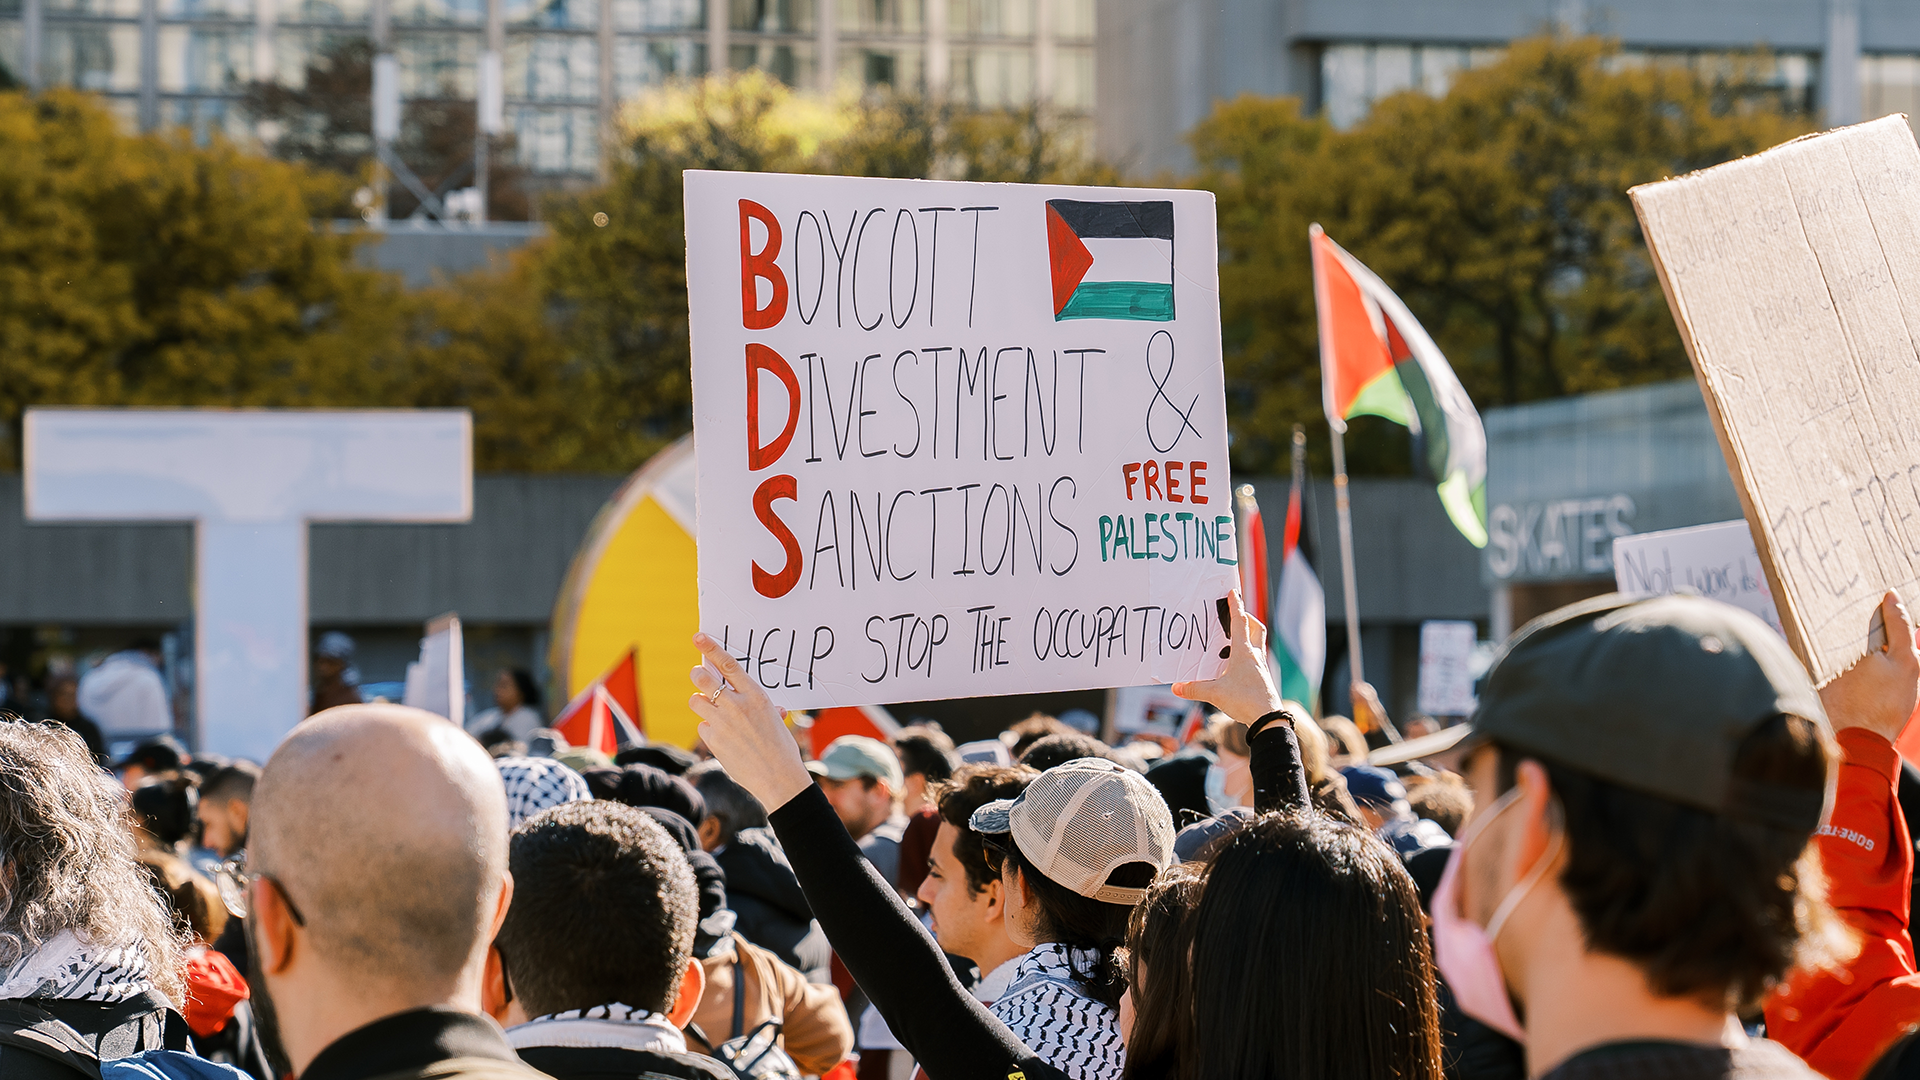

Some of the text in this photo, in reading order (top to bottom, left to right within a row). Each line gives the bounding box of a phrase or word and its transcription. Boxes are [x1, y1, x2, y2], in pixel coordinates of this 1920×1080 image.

[738, 198, 999, 331] BOYCOTT
[745, 330, 1203, 472] DIVESTMENT &
[1122, 460, 1209, 505] FREE
[751, 474, 1079, 598] SANCTIONS
[1099, 512, 1238, 566] PALESTINE
[1488, 493, 1637, 578] SKATES
[1623, 546, 1677, 596] Not
[723, 625, 834, 690] HELP
[861, 613, 949, 684] STOP
[967, 605, 1011, 673] THE
